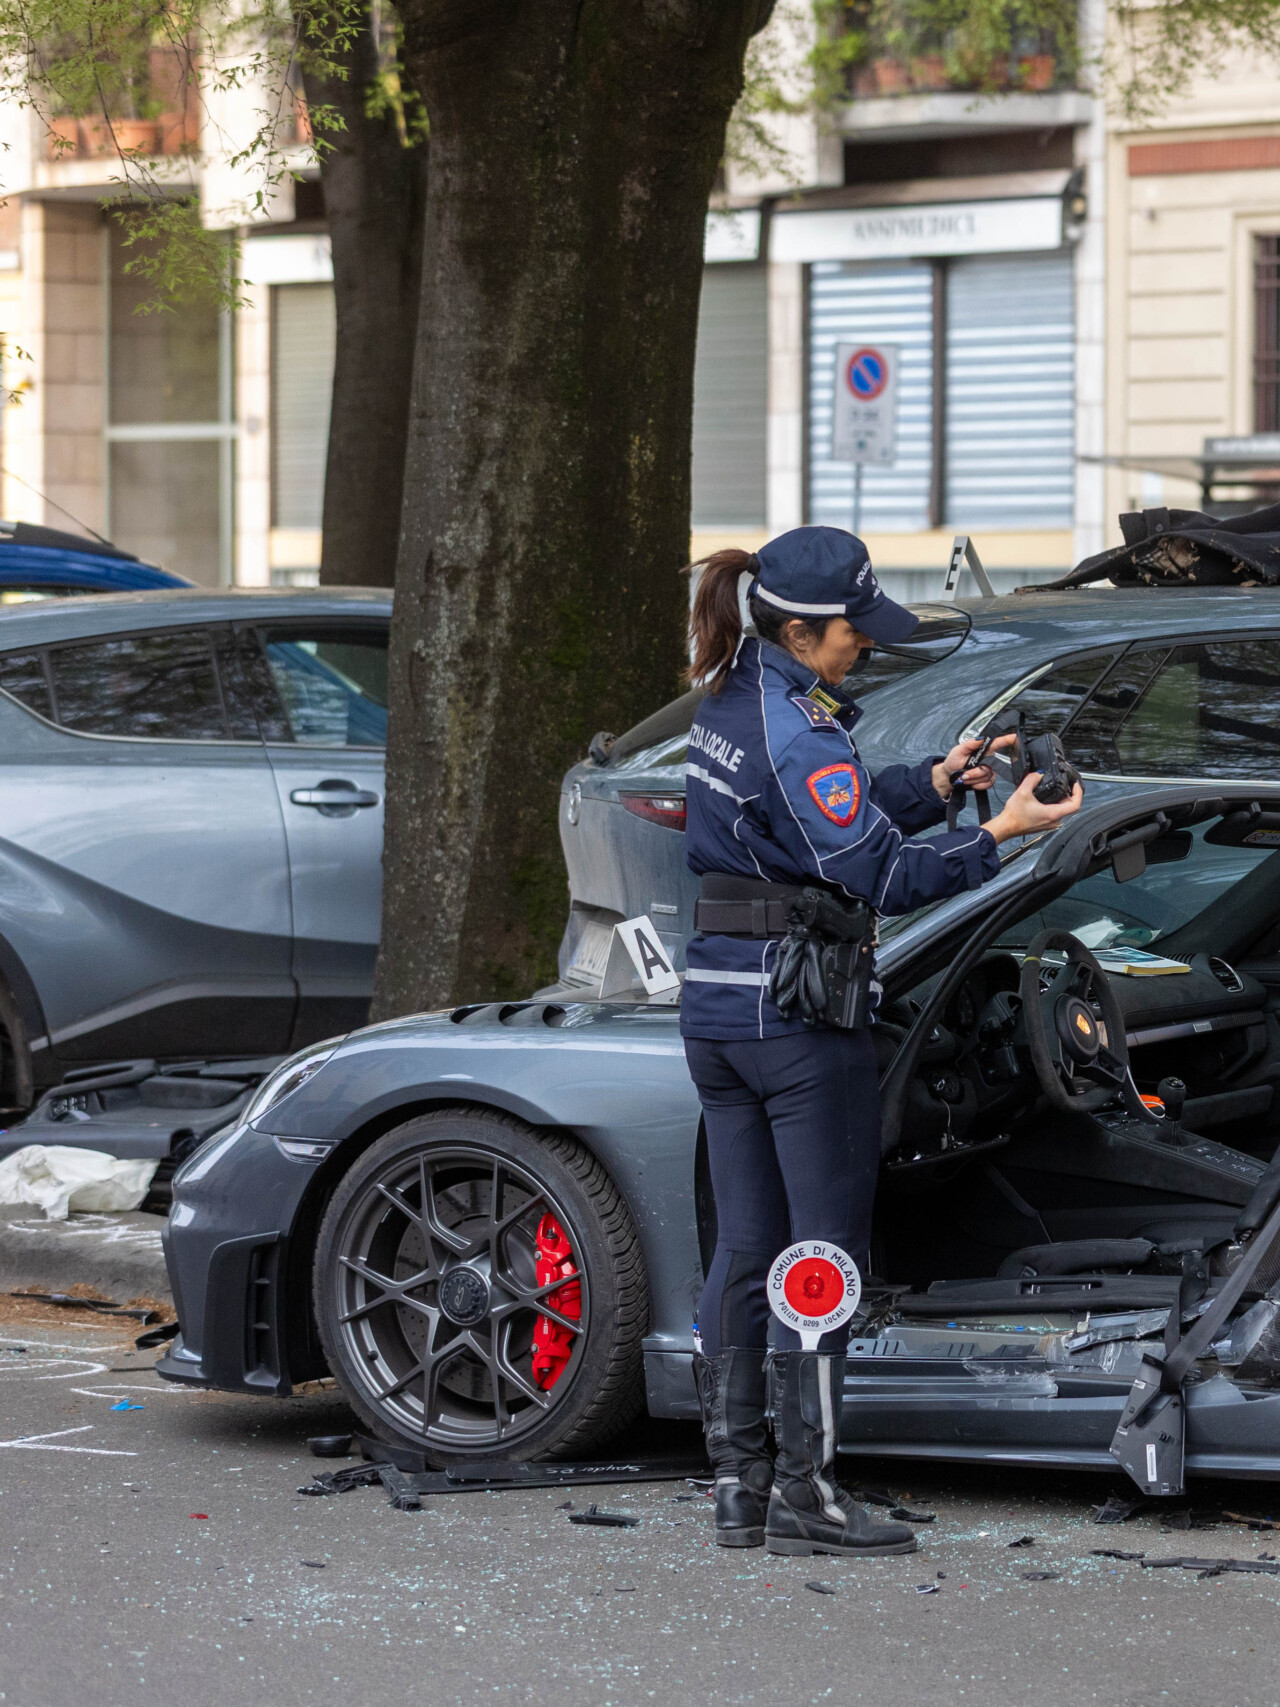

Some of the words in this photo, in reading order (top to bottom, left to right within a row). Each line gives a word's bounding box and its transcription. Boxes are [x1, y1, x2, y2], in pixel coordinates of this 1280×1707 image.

[703, 729, 745, 773] LOCALE
[634, 927, 671, 980] A
[773, 1247, 807, 1290] COMUNE
[813, 1246, 826, 1256] DI
[830, 1252, 856, 1297] MILANO
[778, 1301, 800, 1323] POLIZIA
[803, 1318, 820, 1328] 0209
[823, 1307, 847, 1325] LOCALE
[546, 1466, 576, 1474] RS
[579, 1464, 647, 1473] Spyder
